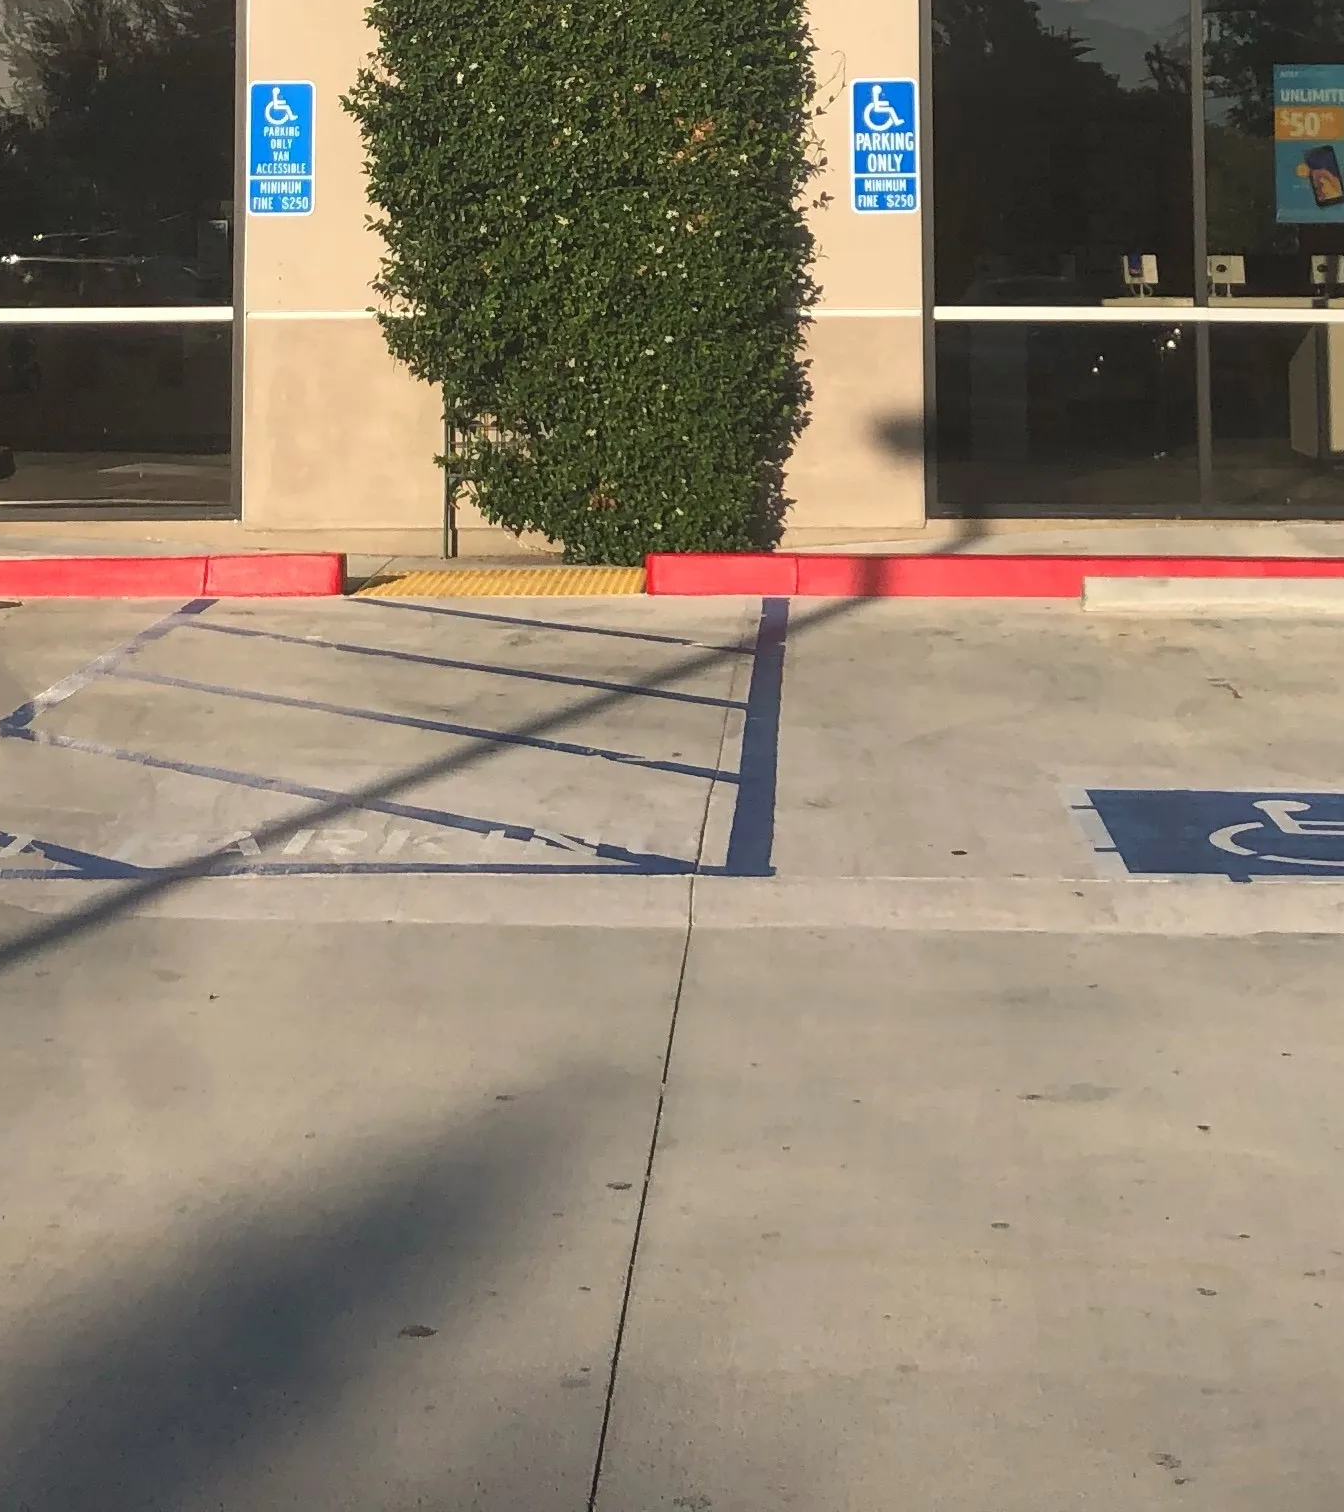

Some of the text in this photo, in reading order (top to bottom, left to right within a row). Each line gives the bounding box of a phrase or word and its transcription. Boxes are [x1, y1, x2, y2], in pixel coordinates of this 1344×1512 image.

[263, 126, 301, 137] PARKING
[270, 138, 293, 149] ONLY
[856, 132, 914, 151] PARKING
[273, 151, 290, 161] VAN
[256, 163, 306, 174] ACCESSIBLE
[867, 153, 904, 172] ONLY
[260, 182, 302, 194] MINIMUM
[864, 179, 907, 192] MINIMUM
[253, 197, 309, 210] FINE $250
[858, 194, 914, 208] FINE $250
